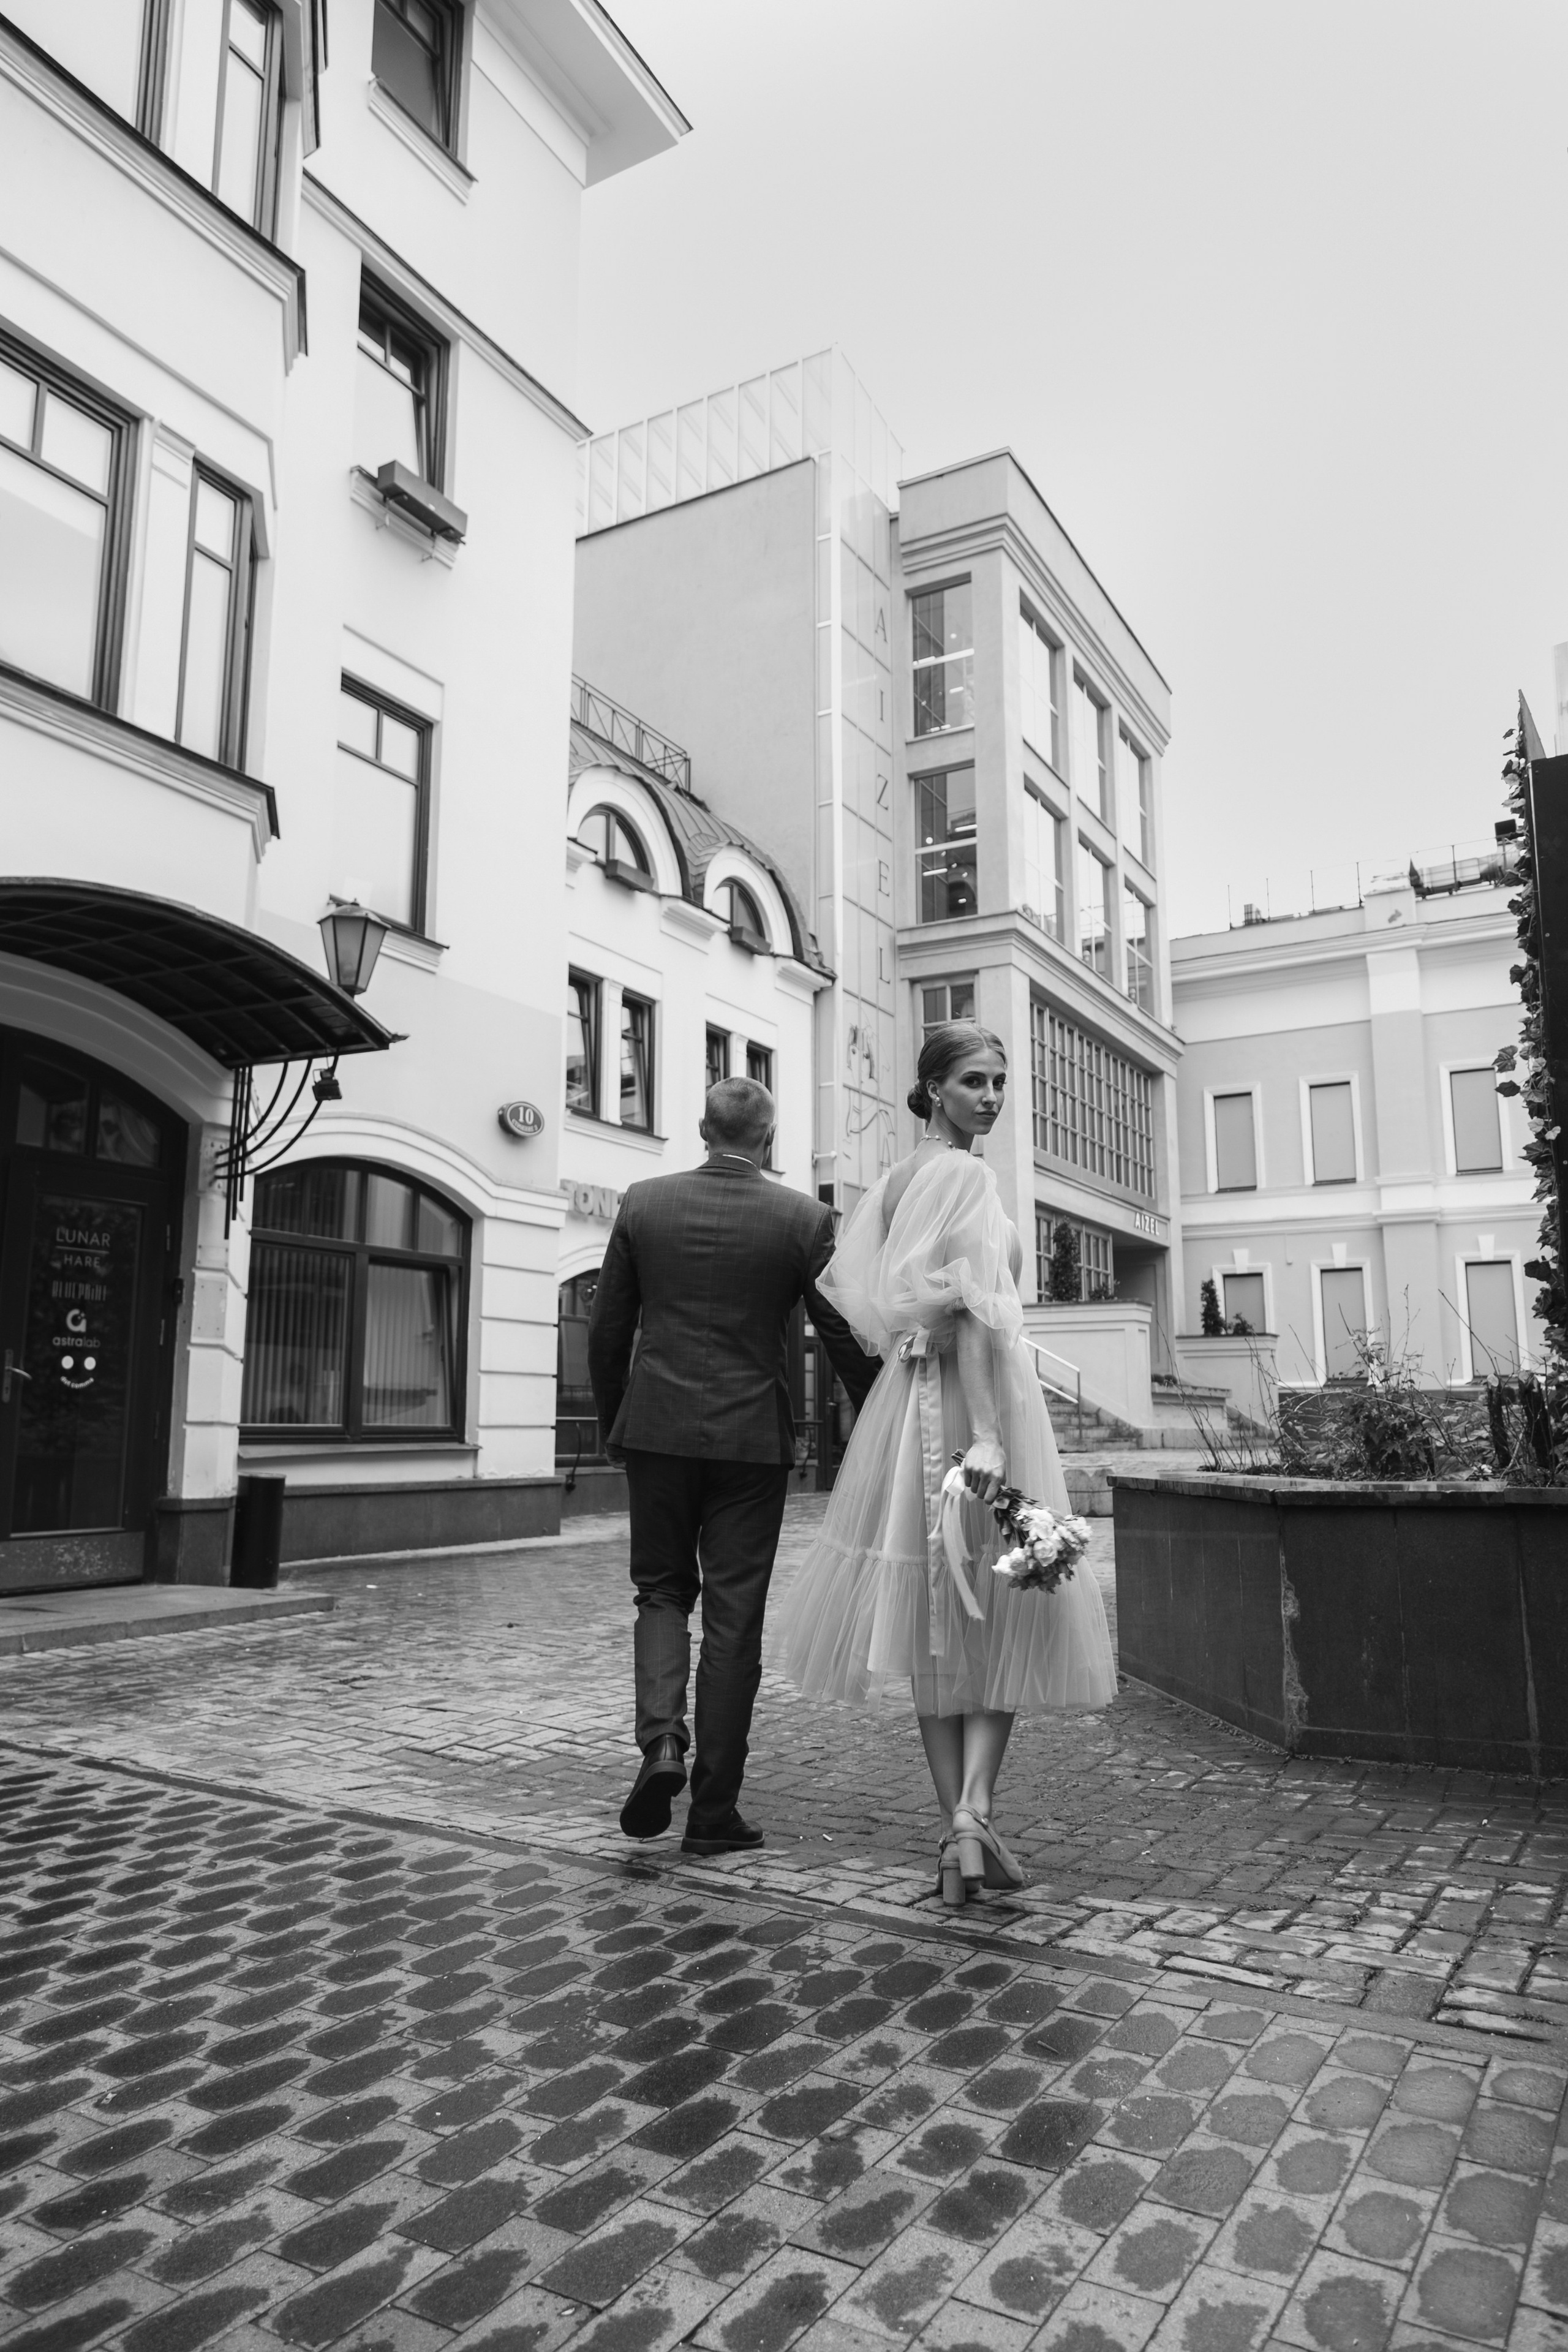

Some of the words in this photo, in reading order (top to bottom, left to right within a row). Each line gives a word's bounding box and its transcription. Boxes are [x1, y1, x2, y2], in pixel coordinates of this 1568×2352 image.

[875, 607, 891, 984] AIZEL
[519, 1106, 533, 1125] 10
[1135, 1212, 1159, 1236] AIZEL
[56, 1227, 110, 1247] LUNAR
[63, 1254, 100, 1268] HARE
[52, 1336, 101, 1348] astralab
